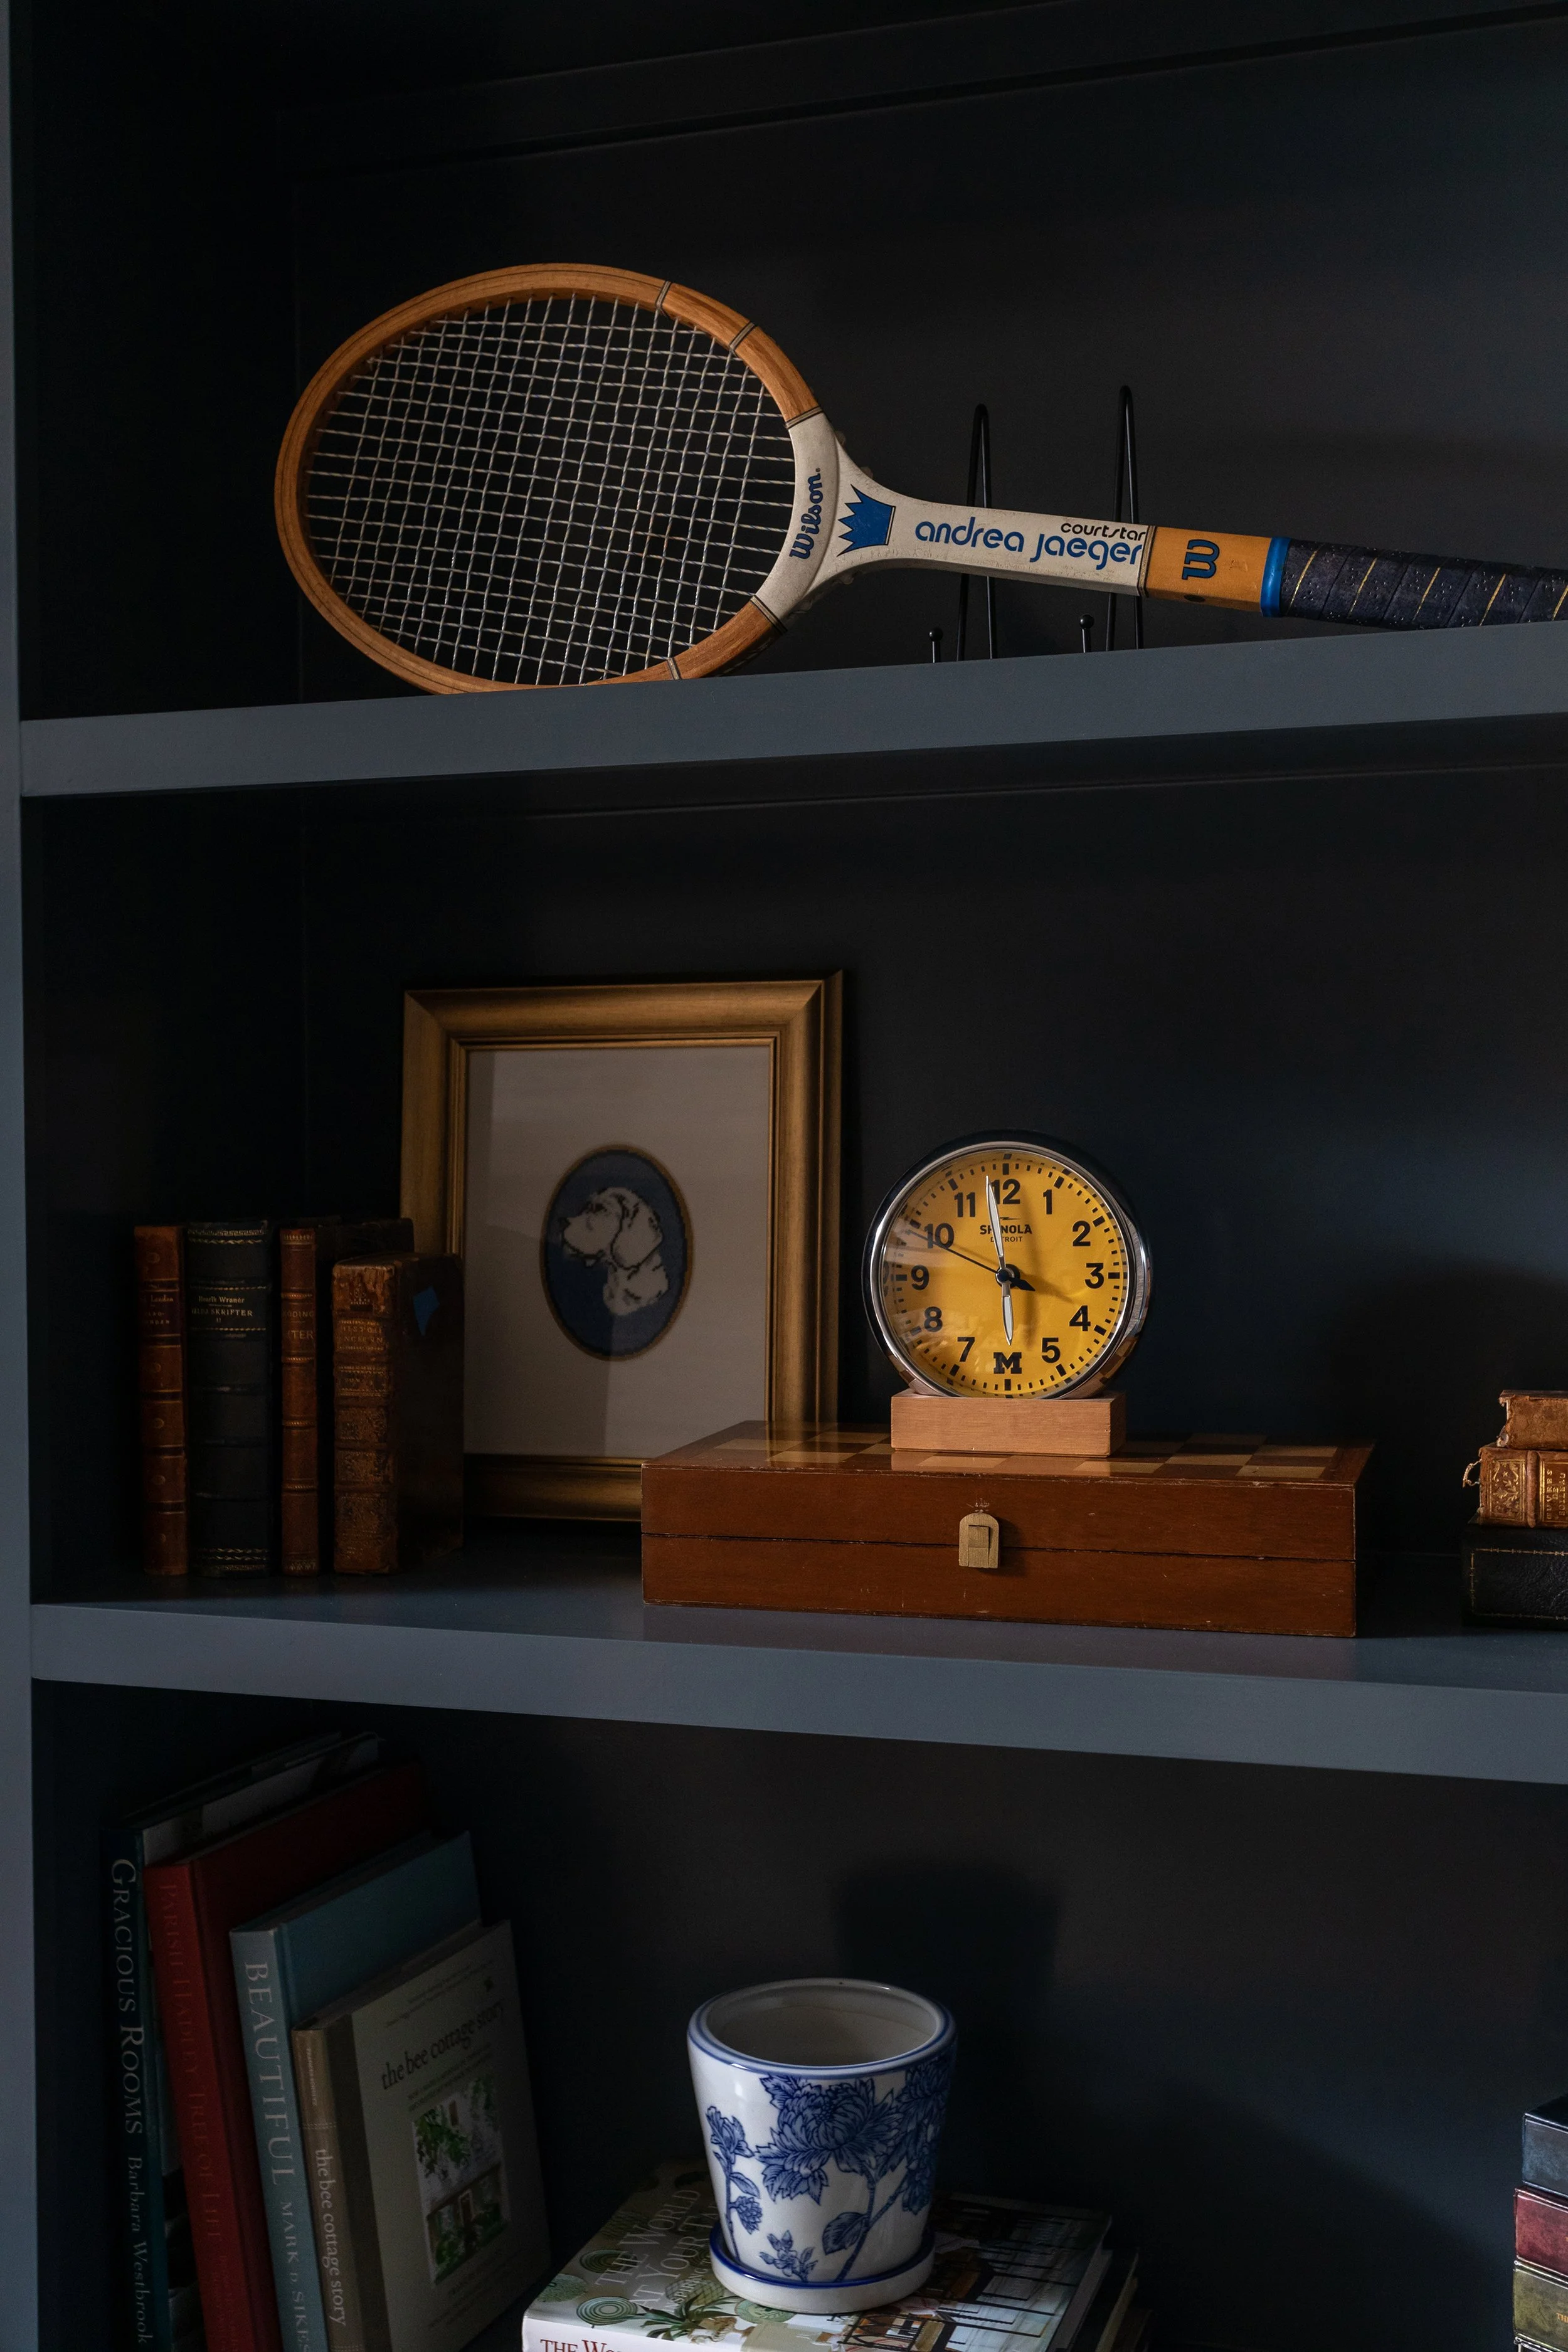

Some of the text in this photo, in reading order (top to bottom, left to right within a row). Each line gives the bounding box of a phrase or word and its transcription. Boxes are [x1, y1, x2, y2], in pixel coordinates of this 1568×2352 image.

[789, 470, 823, 559] Wilson
[914, 516, 1144, 570] andrea jaeger
[1060, 522, 1147, 541] courtstar
[953, 1192, 977, 1218] 11
[990, 1179, 1022, 1205] 12
[1042, 1189, 1054, 1216] 1
[923, 1222, 955, 1249] 10
[1071, 1220, 1091, 1247] 2
[909, 1265, 930, 1291] 9
[1084, 1263, 1104, 1289] 3
[210, 1308, 254, 1317] SKRIFTER
[923, 1306, 944, 1333] 8
[1069, 1305, 1091, 1332] 4
[956, 1336, 976, 1363] 7
[1041, 1337, 1061, 1364] 5
[992, 1352, 1023, 1375] M
[381, 2061, 405, 2090] the
[403, 2050, 428, 2075] bee
[430, 2019, 475, 2059] cottage
[110, 1858, 154, 2344] GRACIOUS ROOMS Barbara Westbrook
[244, 1961, 295, 2186] BEAUTIFUL
[280, 2201, 300, 2264] MARK
[314, 2148, 347, 2327] the bee cottage story
[594, 2189, 701, 2286] THE WORLD
[635, 2235, 710, 2280] YOUR
[628, 2284, 665, 2311] AT
